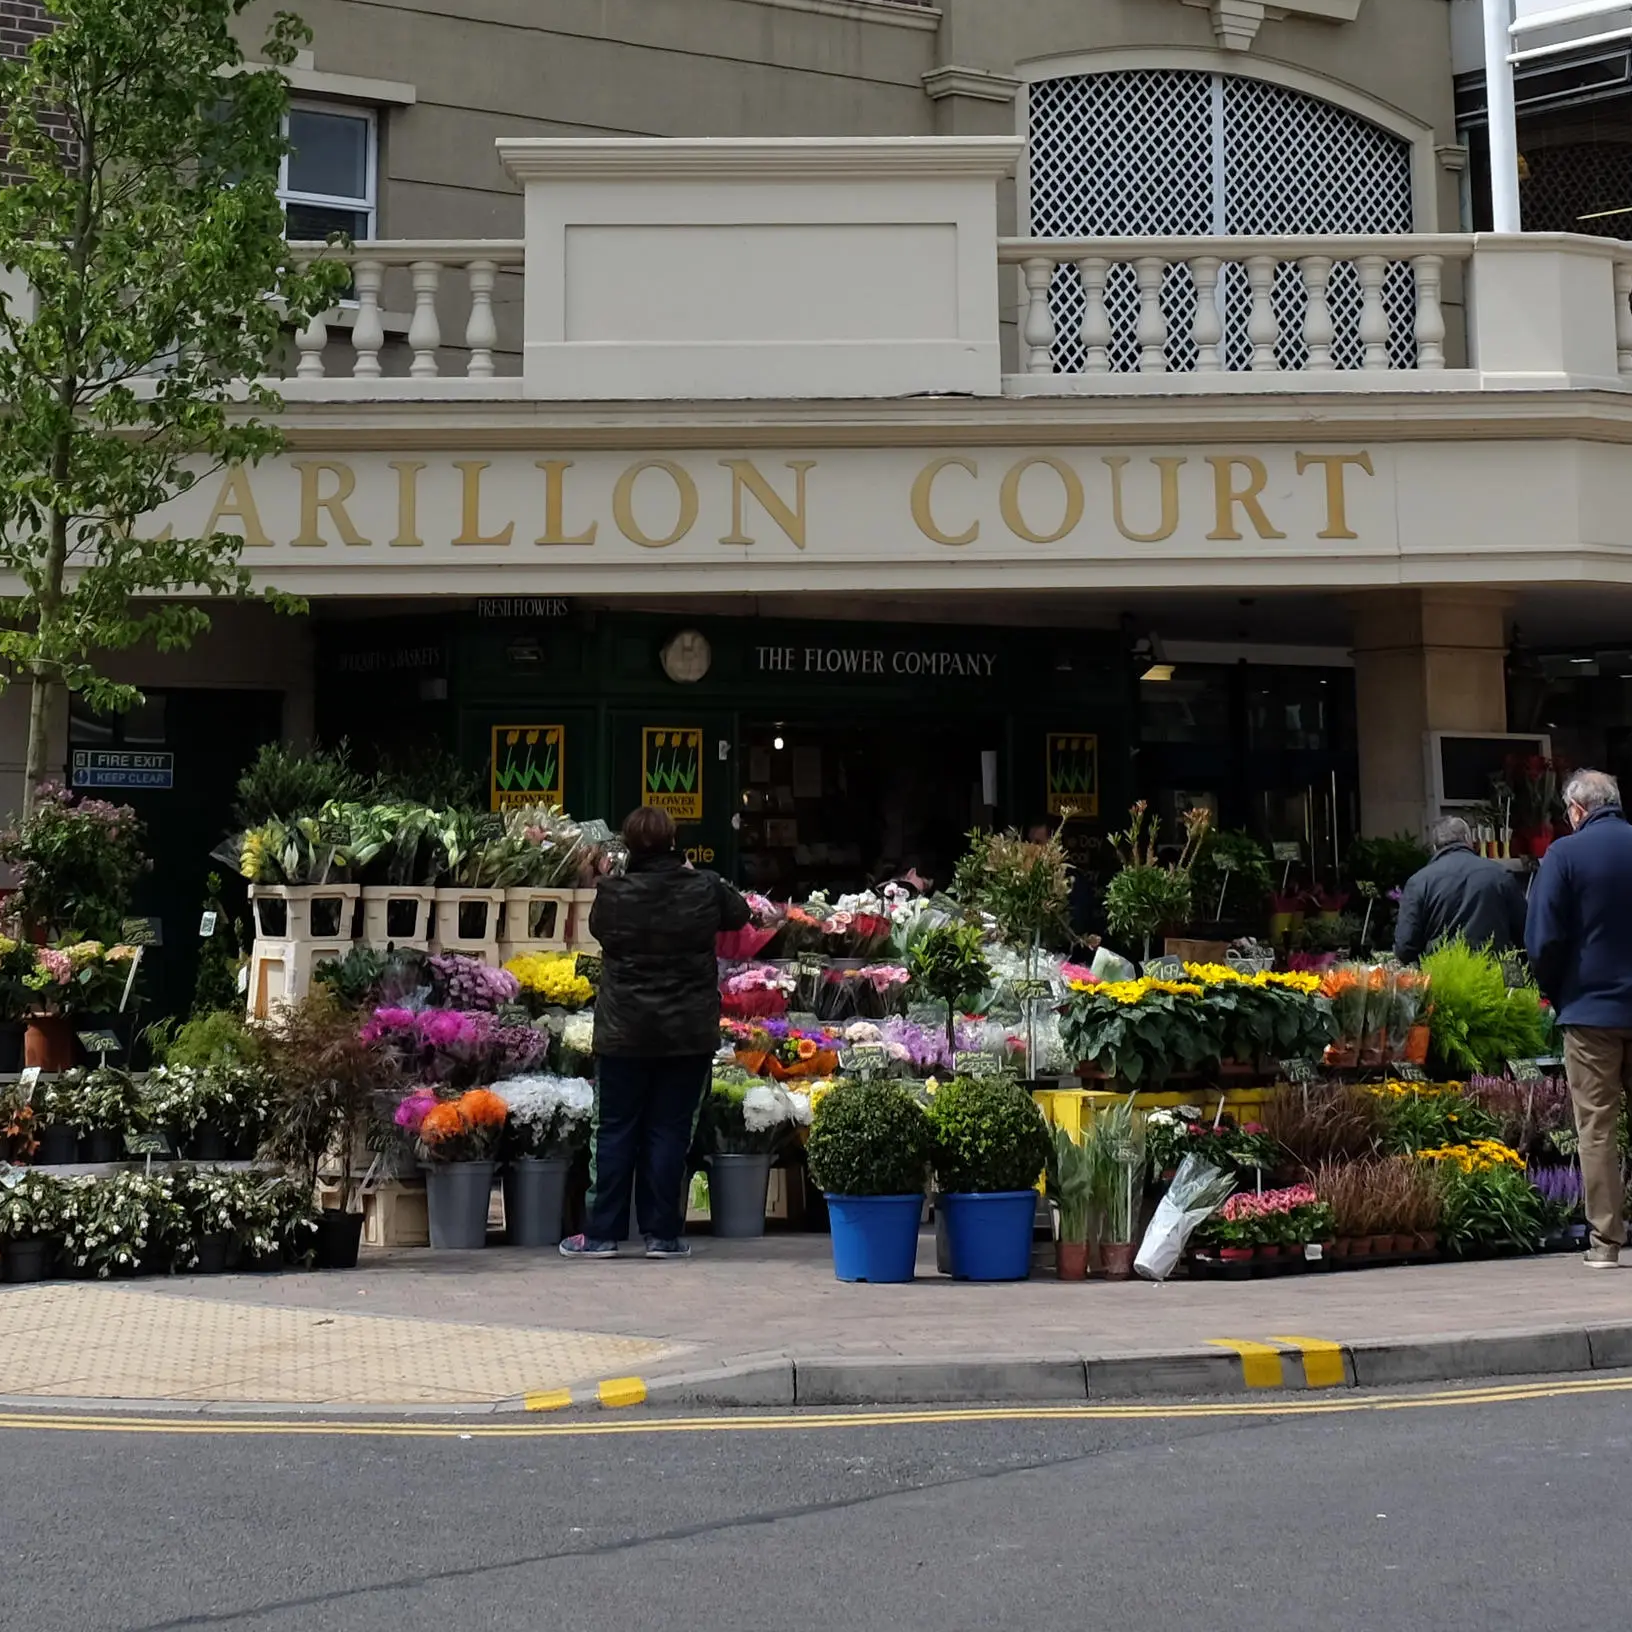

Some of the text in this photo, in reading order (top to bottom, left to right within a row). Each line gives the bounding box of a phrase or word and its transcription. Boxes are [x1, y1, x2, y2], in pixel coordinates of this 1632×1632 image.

[113, 449, 1374, 549] ARILLON COURT
[478, 598, 569, 618] FRESH FLOWERS
[755, 646, 998, 676] THE FLOWER COMPANY
[98, 754, 165, 768] FIRE EXIT
[96, 772, 165, 783] KEEP CLEAR
[499, 793, 555, 805] FLOWER
[649, 796, 696, 806] FLOWER
